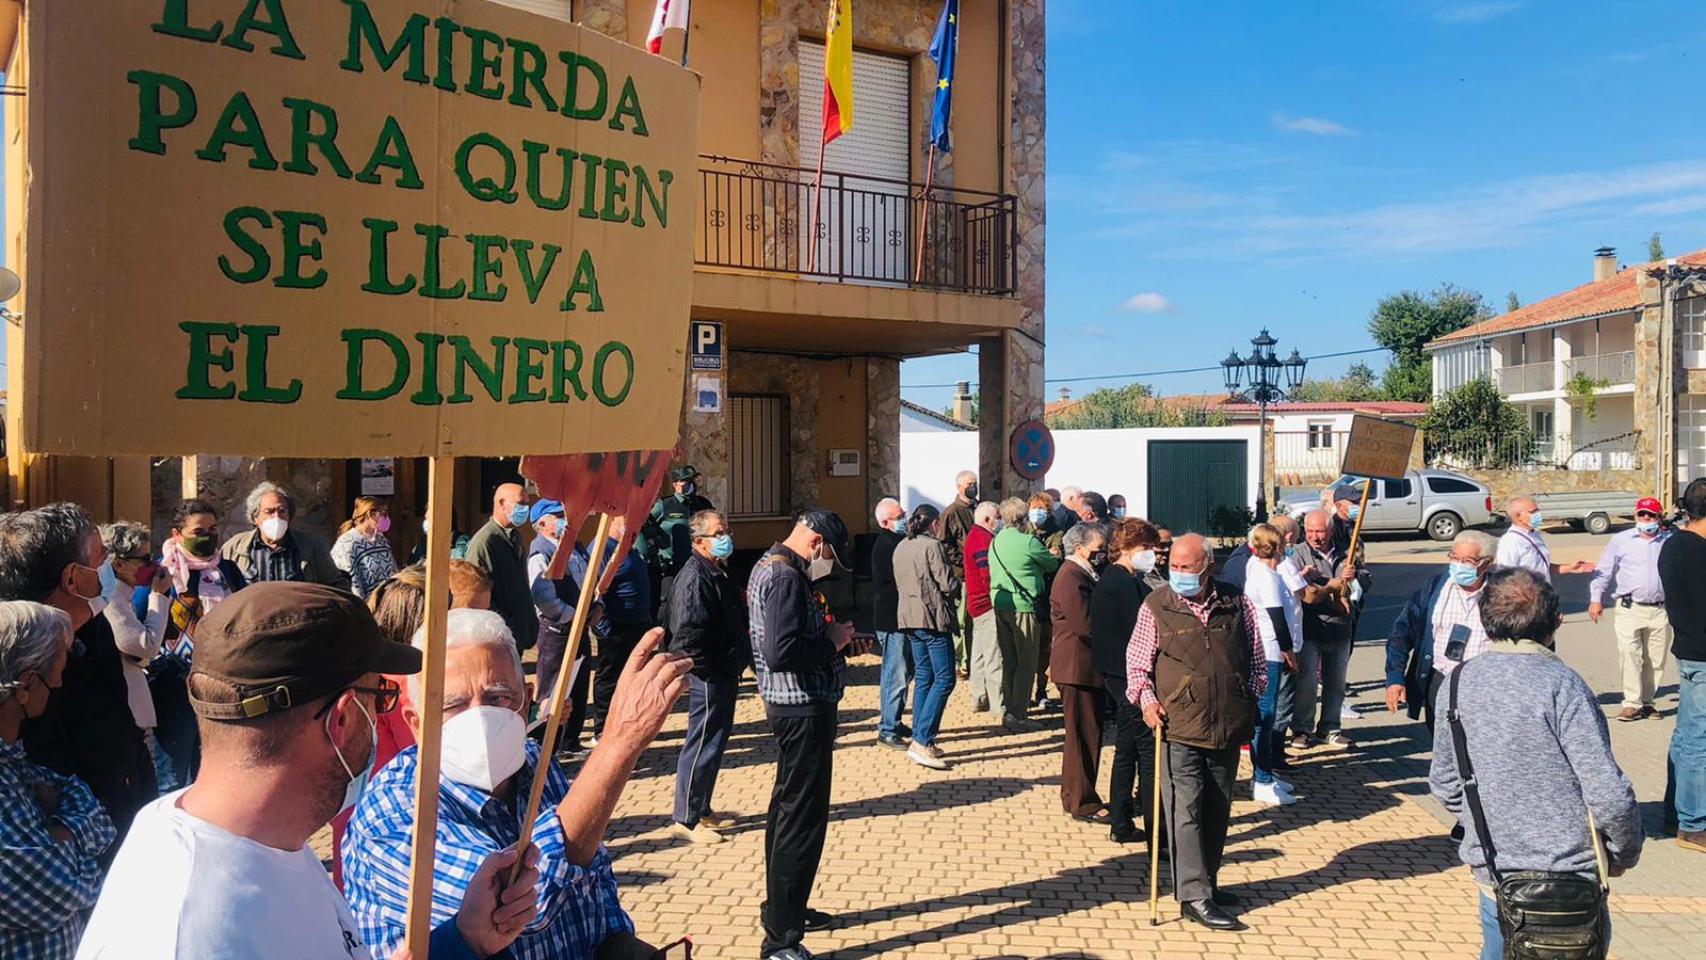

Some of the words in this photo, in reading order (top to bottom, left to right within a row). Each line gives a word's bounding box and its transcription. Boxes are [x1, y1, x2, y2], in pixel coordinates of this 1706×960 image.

[151, 0, 306, 60] LA
[339, 0, 649, 136] MIERDA
[127, 69, 424, 190] PARA
[454, 132, 673, 229] QUIEN
[218, 206, 329, 289] SE
[361, 218, 605, 313] LLEVA
[176, 321, 303, 405] EL
[336, 328, 635, 407] DINERO
[698, 325, 716, 353] P
